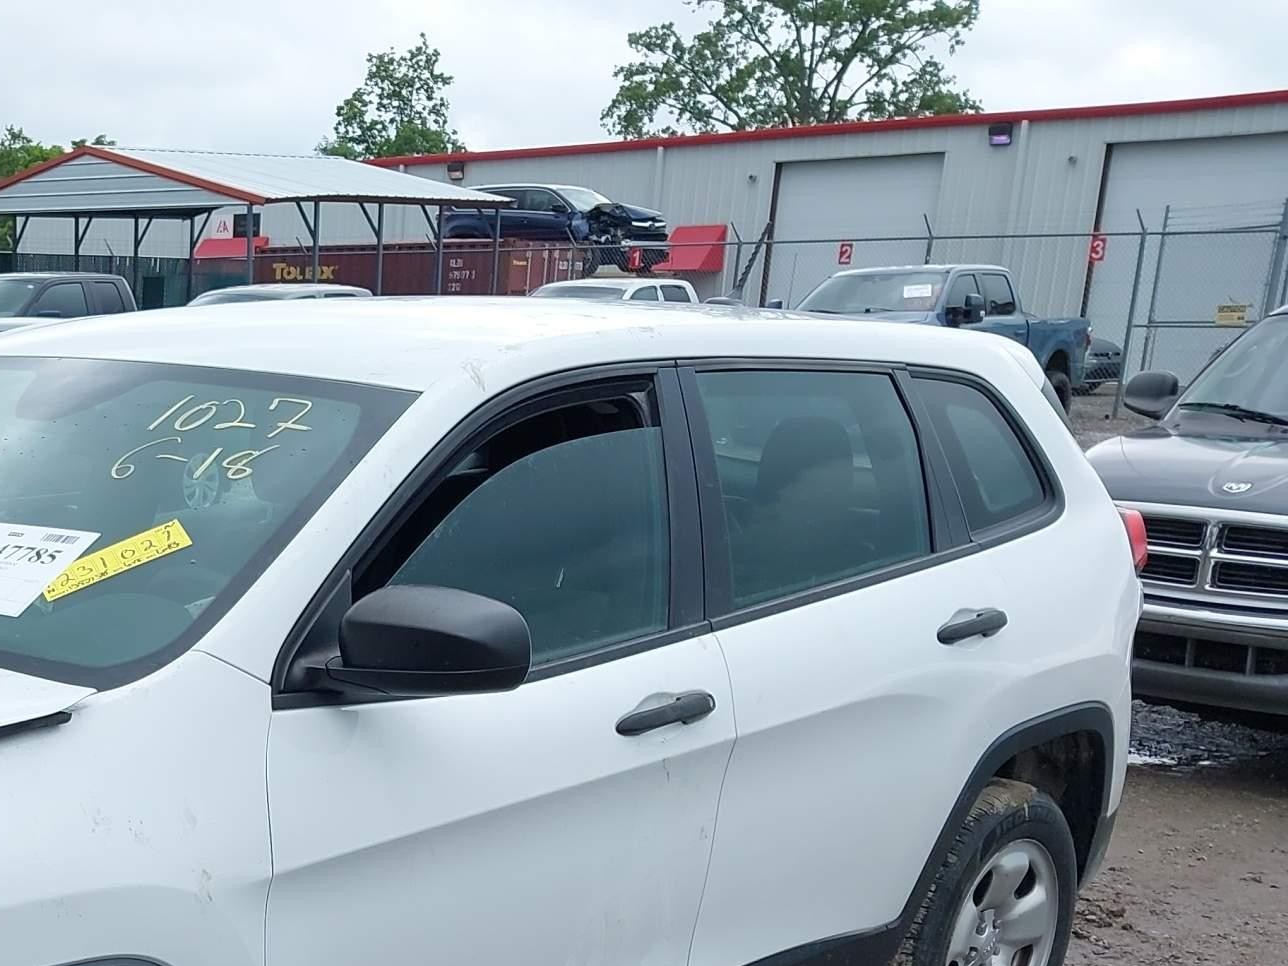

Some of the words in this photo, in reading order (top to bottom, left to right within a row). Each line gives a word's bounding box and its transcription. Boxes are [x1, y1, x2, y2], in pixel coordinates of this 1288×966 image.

[840, 245, 852, 263] 2
[1091, 240, 1104, 259] 3
[146, 394, 313, 438] 1027
[111, 436, 280, 479] 6-18
